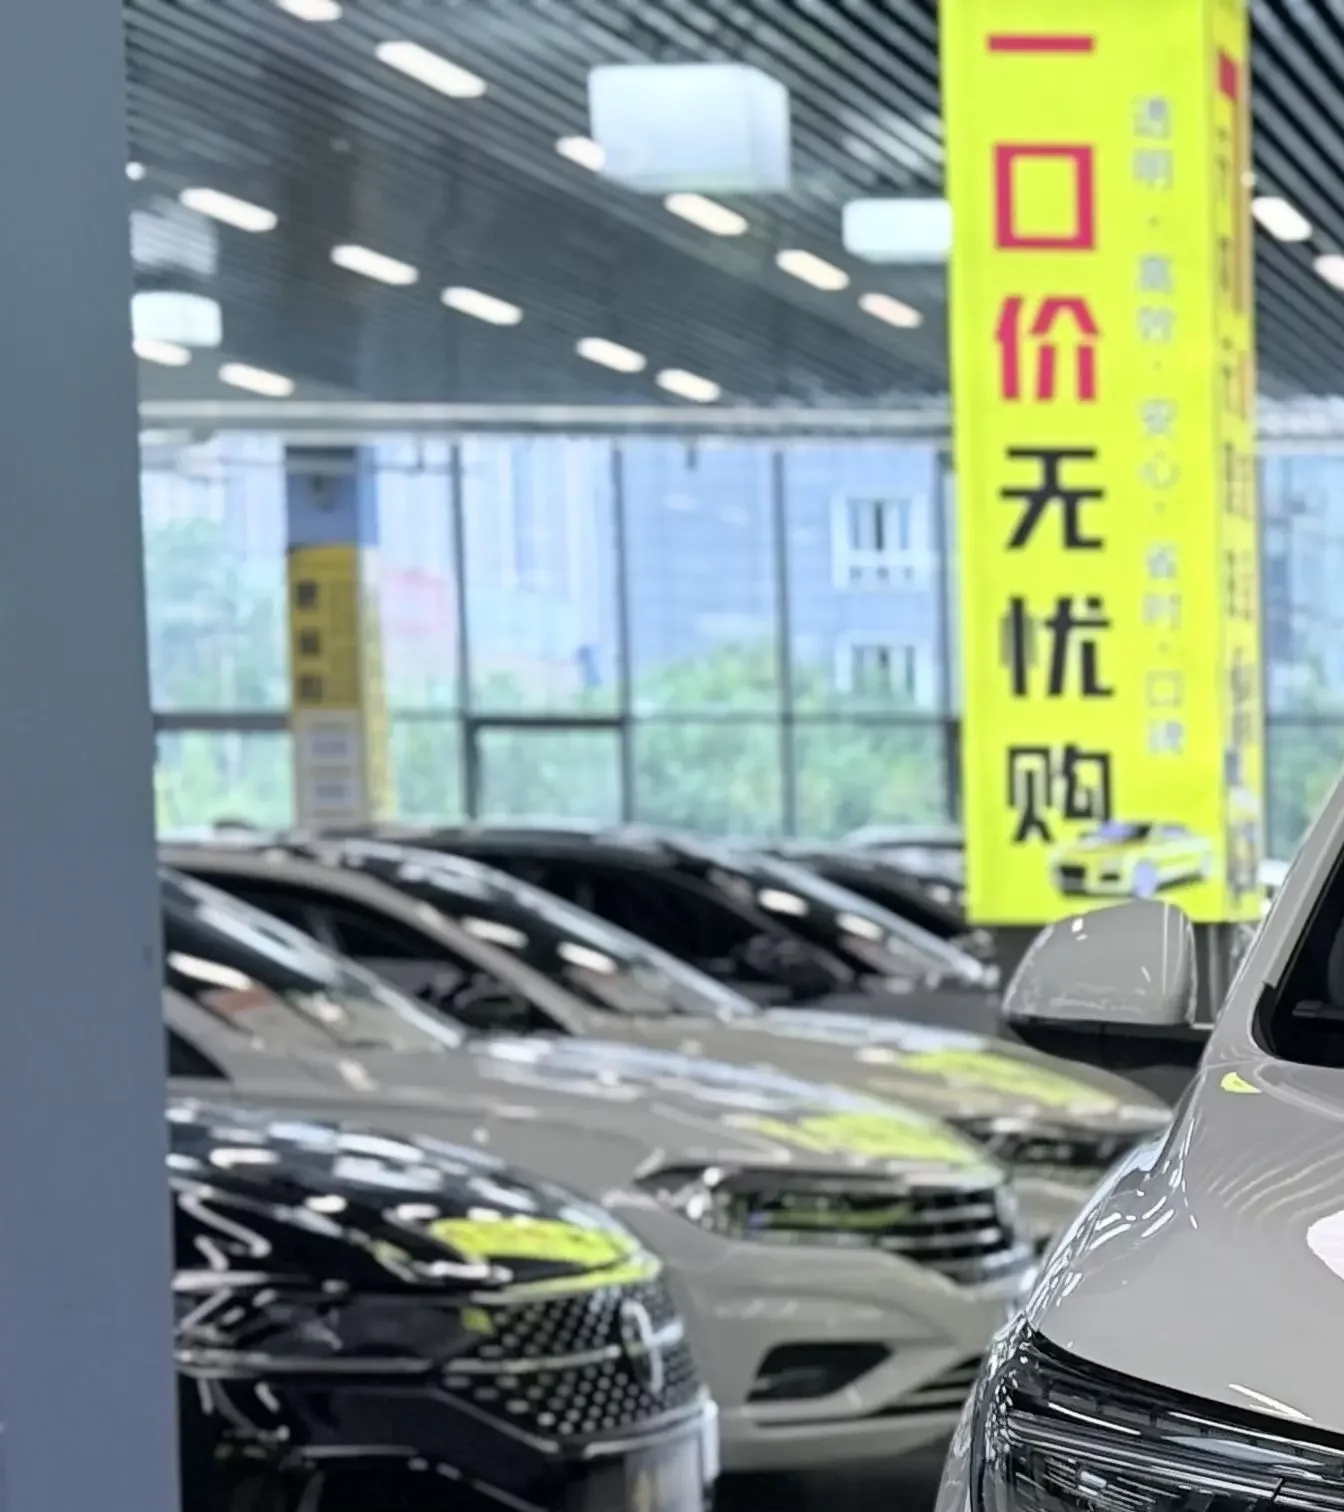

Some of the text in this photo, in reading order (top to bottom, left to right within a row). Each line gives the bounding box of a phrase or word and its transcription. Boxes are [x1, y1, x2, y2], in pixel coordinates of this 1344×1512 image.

[987, 35, 1114, 844] 一口价无忧购
